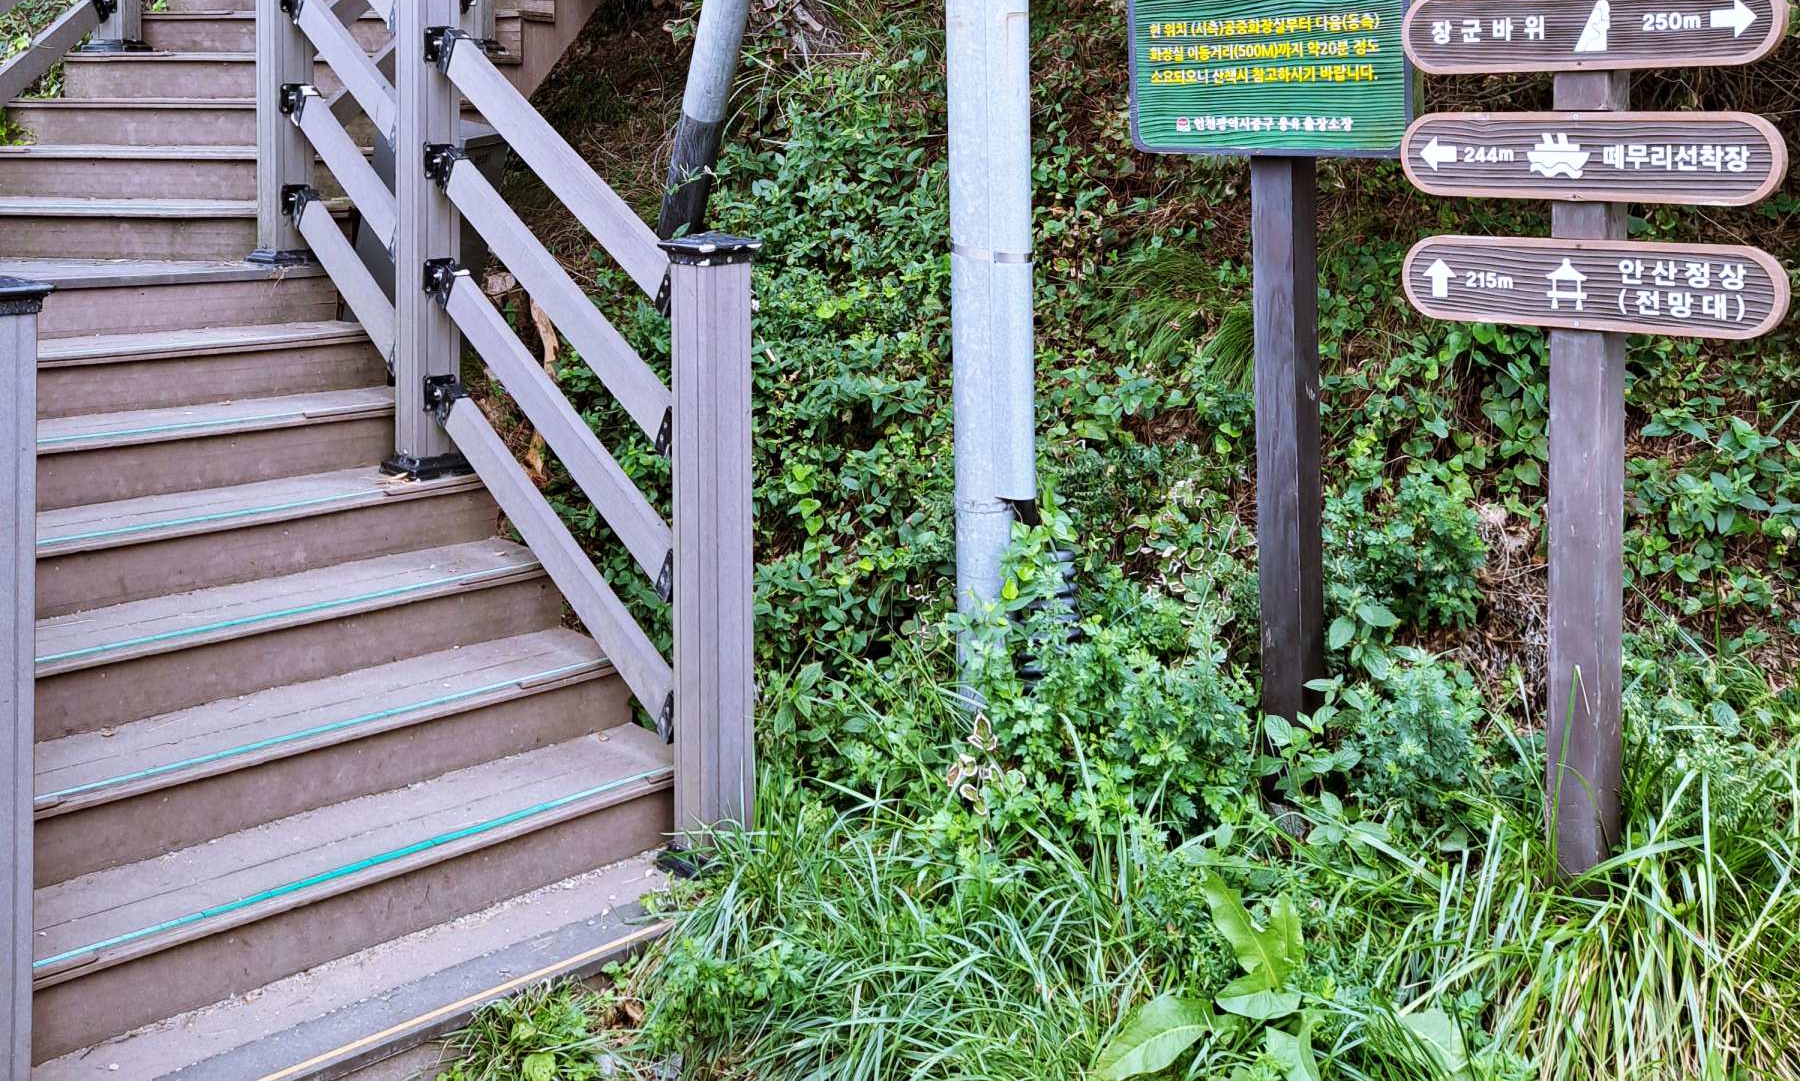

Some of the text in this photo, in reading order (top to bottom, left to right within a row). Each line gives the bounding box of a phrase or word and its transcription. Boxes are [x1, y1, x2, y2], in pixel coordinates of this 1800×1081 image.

[1150, 23, 1160, 38] 현
[1164, 21, 1187, 37] 위치
[1315, 12, 1380, 32] 다음(동측)
[1642, 13, 1702, 31] 250m
[1150, 38, 1380, 62] 화장실 이동거리(500M)까지 약20분 정도
[1151, 63, 1378, 86] 소요되오니 산책시 참고하시기 바랍니다.
[1193, 116, 1275, 132] 인천광역시중구
[1463, 144, 1751, 173] 244m 떼무리선착장
[1465, 271, 1513, 290] 215m
